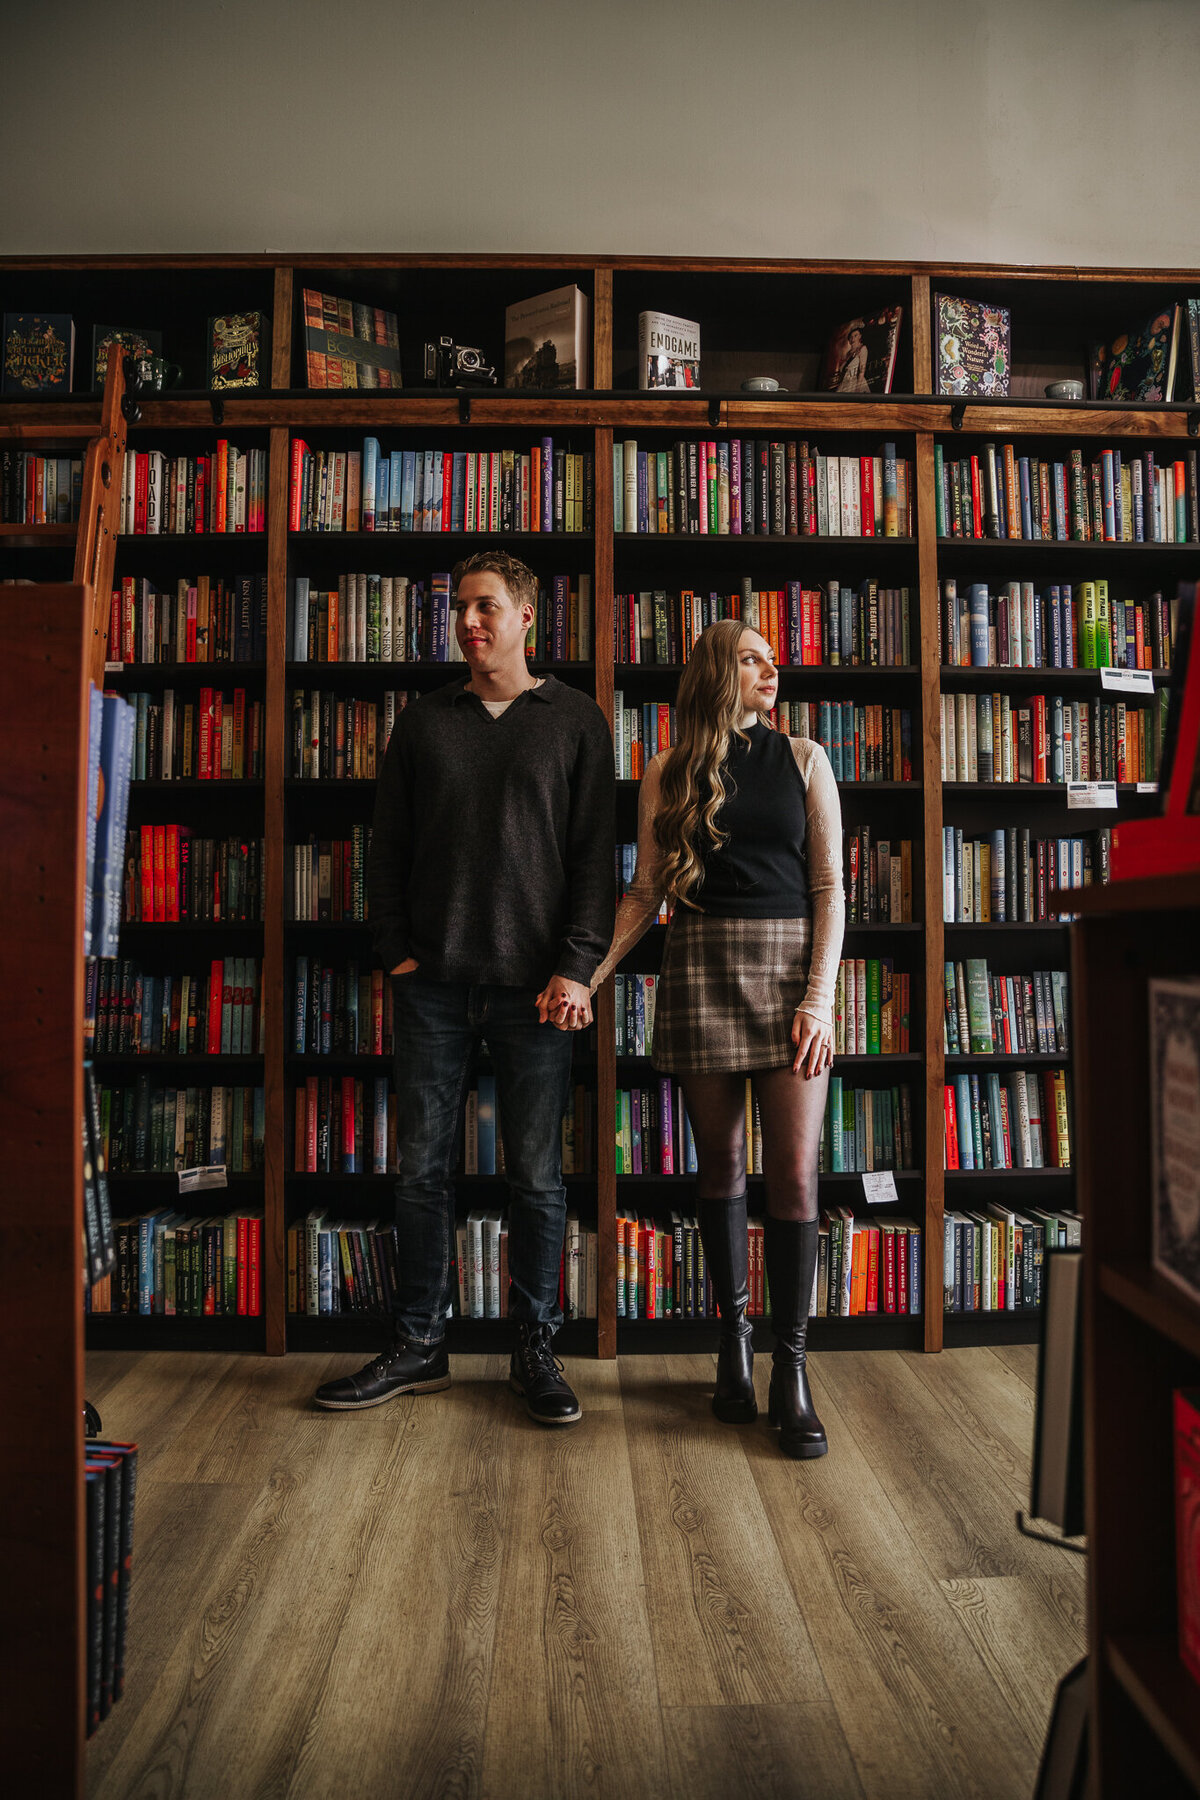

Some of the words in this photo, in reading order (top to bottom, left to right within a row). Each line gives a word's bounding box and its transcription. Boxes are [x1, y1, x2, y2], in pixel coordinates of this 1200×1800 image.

[328, 338, 384, 366] BOOKS
[651, 332, 698, 358] ENDGAME
[962, 347, 989, 358] Wonderful
[966, 355, 984, 364] Nature
[242, 580, 250, 596] KEN
[242, 597, 250, 629] FOLLETT
[367, 624, 378, 654] Search
[1082, 742, 1088, 752] MY
[960, 1008, 969, 1043] STEALING
[1017, 1076, 1027, 1110] Adelaide
